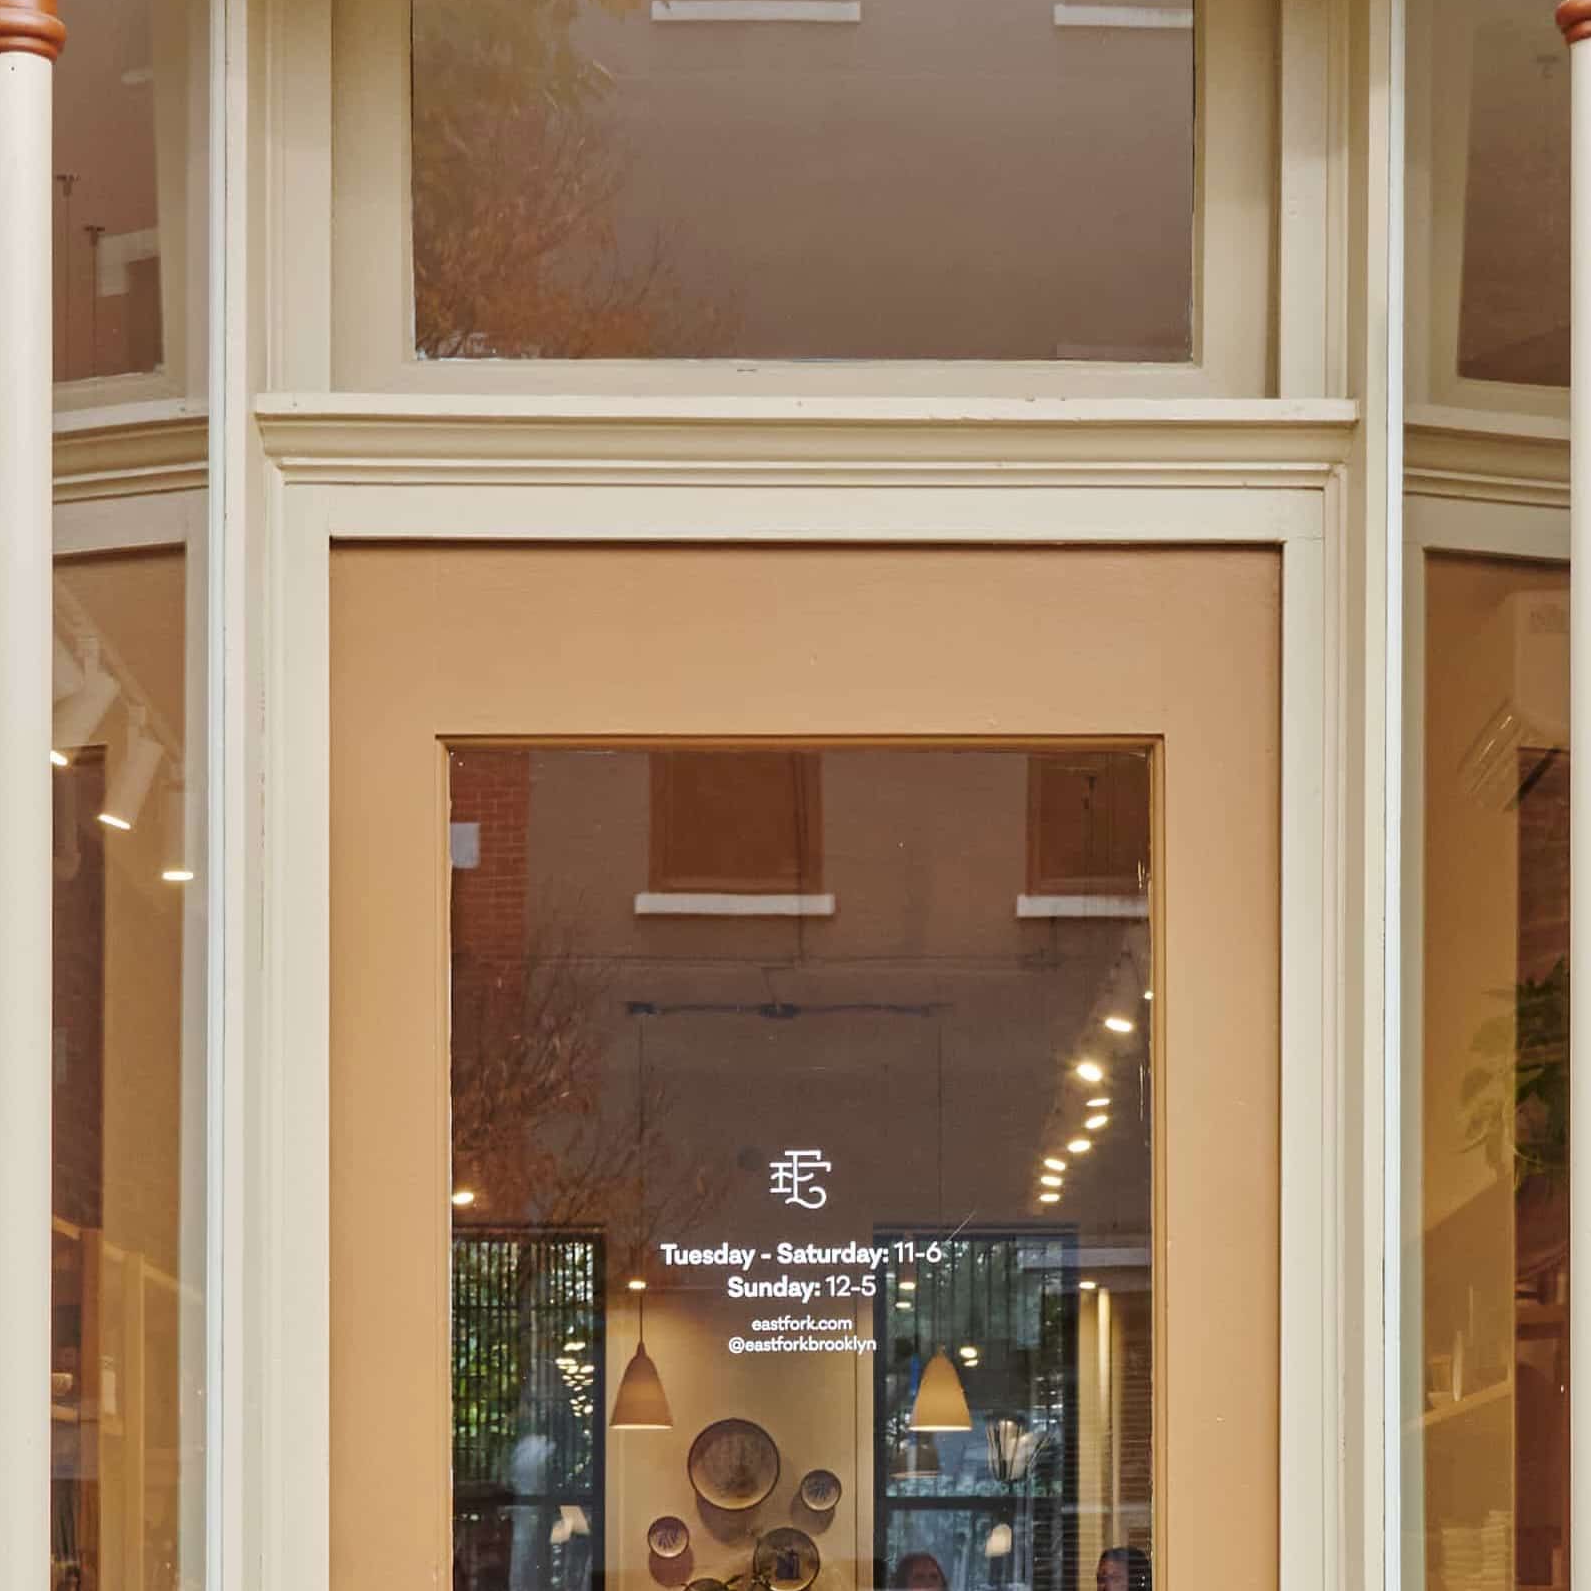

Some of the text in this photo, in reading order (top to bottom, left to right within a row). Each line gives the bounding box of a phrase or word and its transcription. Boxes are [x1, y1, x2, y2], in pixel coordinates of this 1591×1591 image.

[660, 1243, 756, 1270] Tuesday
[777, 1241, 889, 1269] Saturday:
[894, 1241, 942, 1263] 11-6
[728, 1276, 876, 1303] Sunday: 12-5
[751, 1315, 853, 1331] eastfork.com
[728, 1336, 877, 1354] @eastforkbrooklyn
